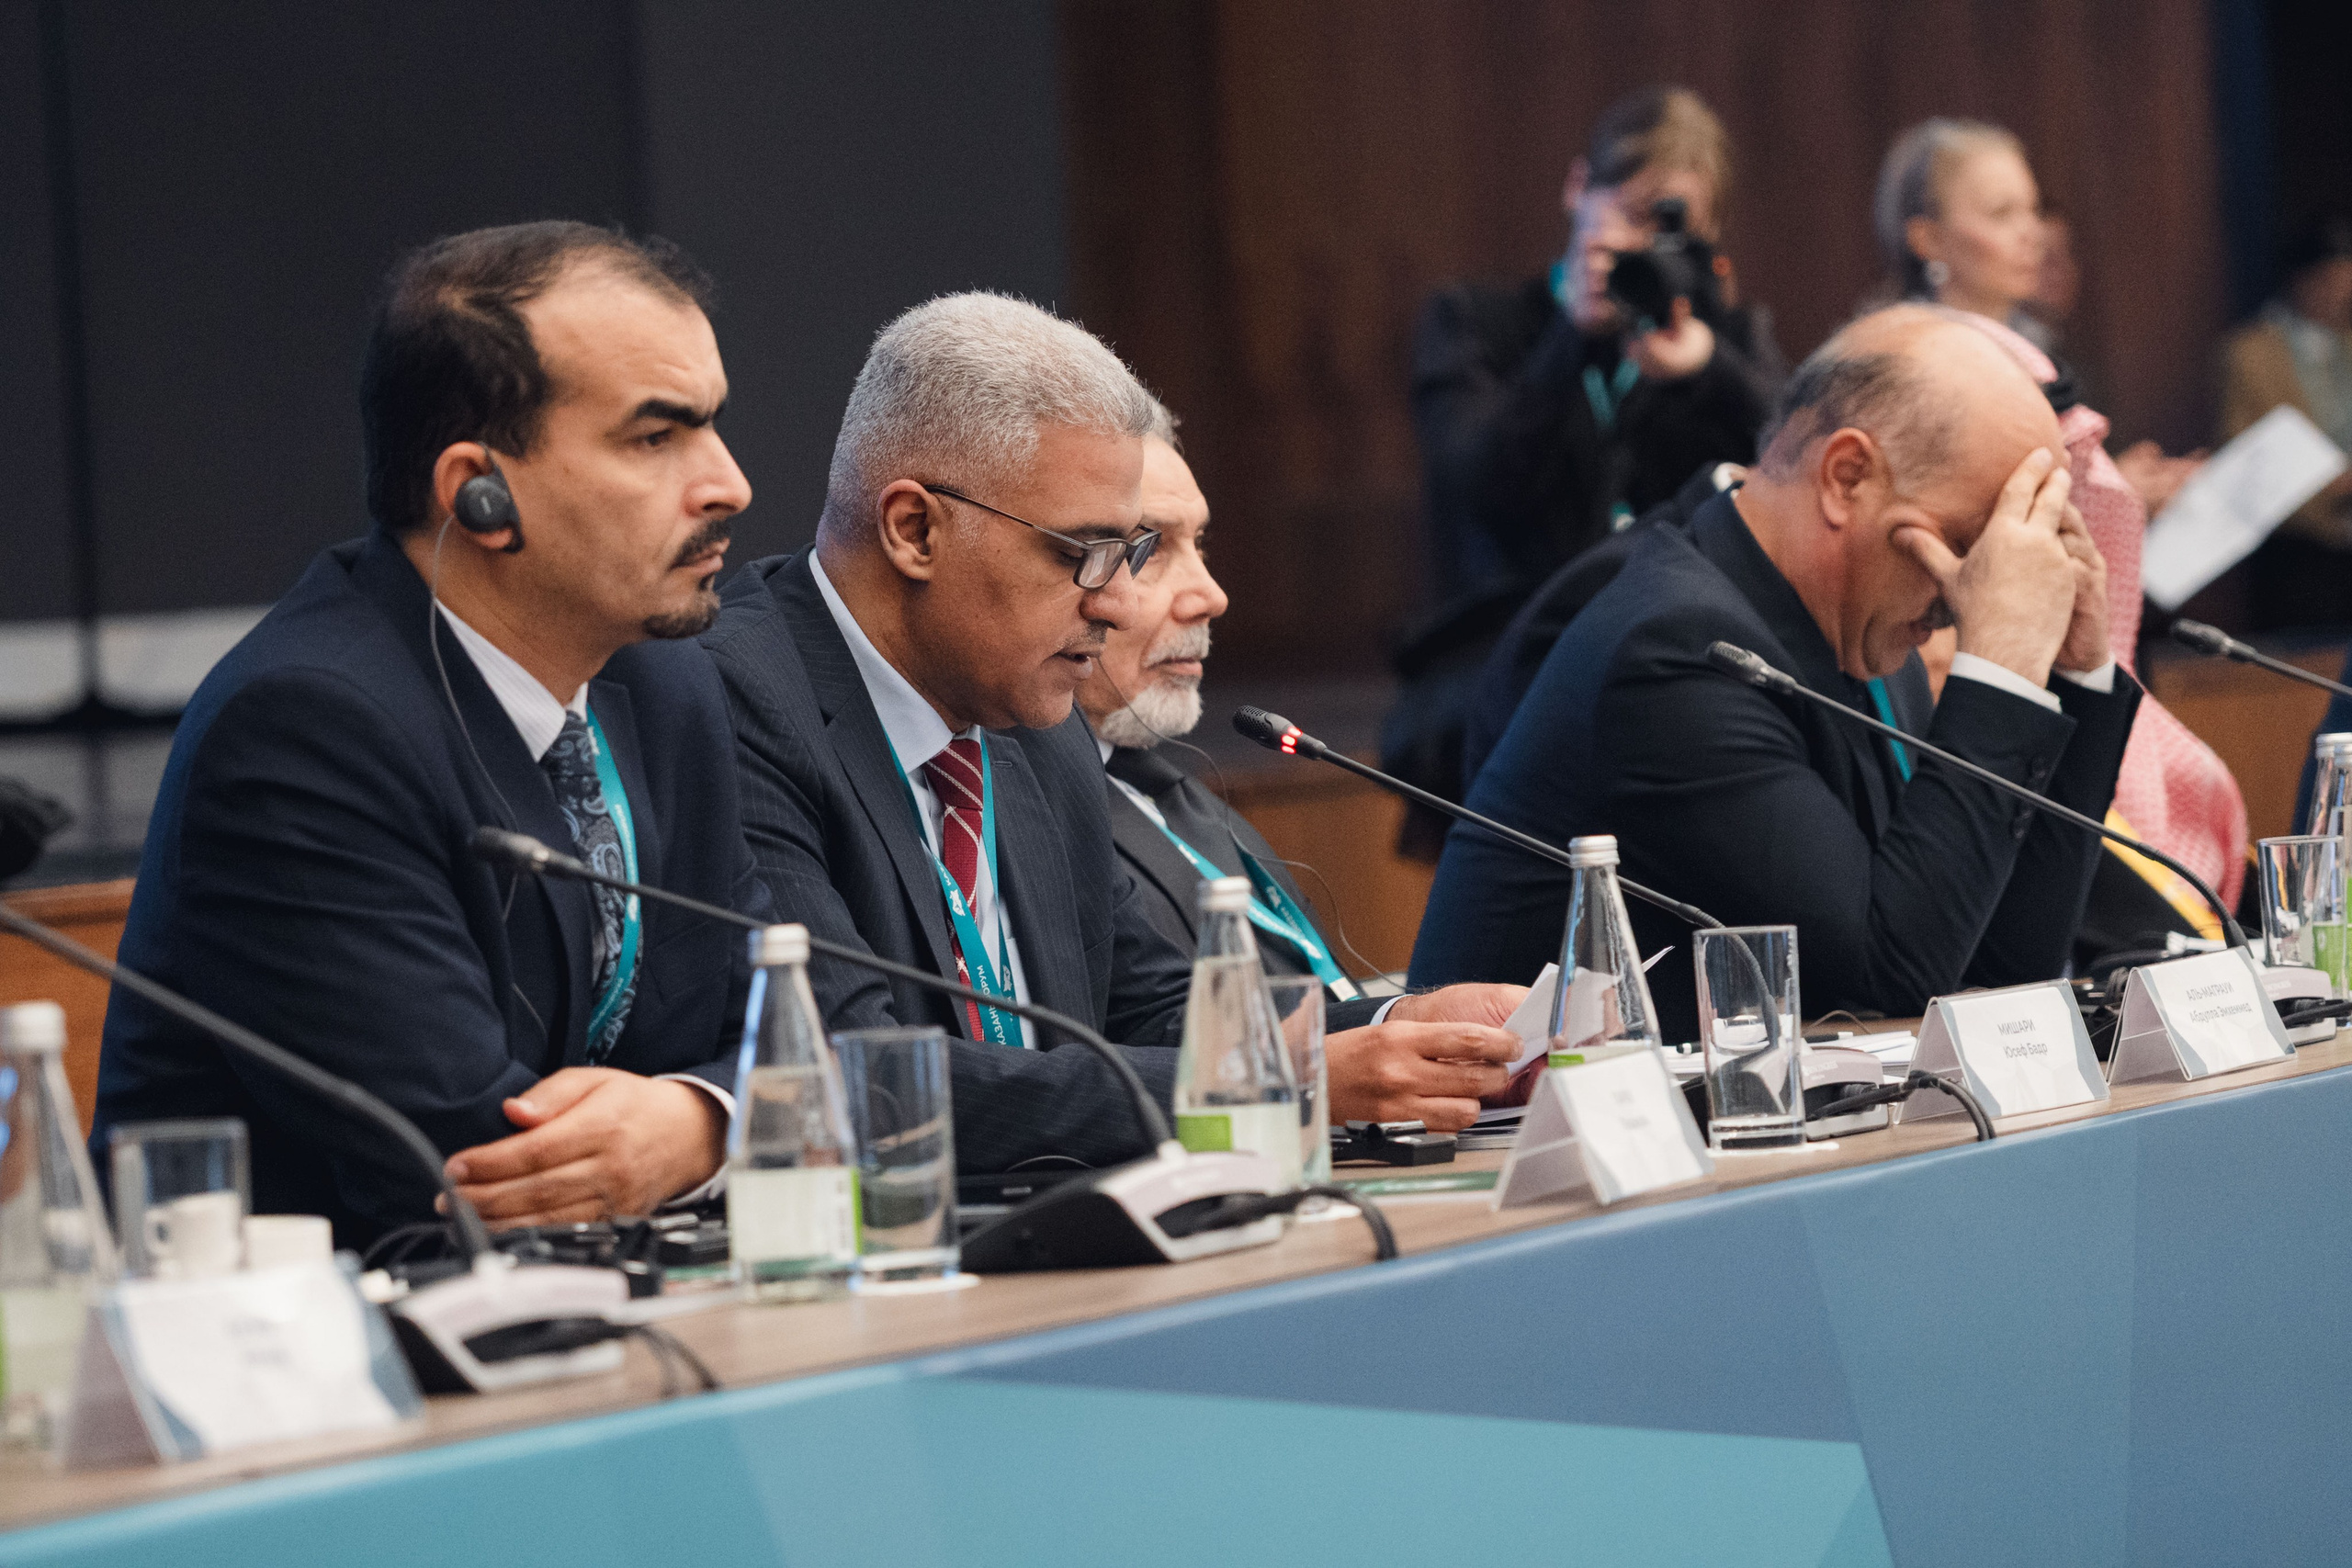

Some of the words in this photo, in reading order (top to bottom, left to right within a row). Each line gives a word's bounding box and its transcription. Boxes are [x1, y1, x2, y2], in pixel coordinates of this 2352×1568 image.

[2186, 981, 2234, 1001] АЛЬ-МАГРАУИ
[1997, 1019, 2036, 1035] МИШАРИ
[2003, 1043, 2029, 1059] Юсеф
[2028, 1042, 2048, 1056] Бадр
